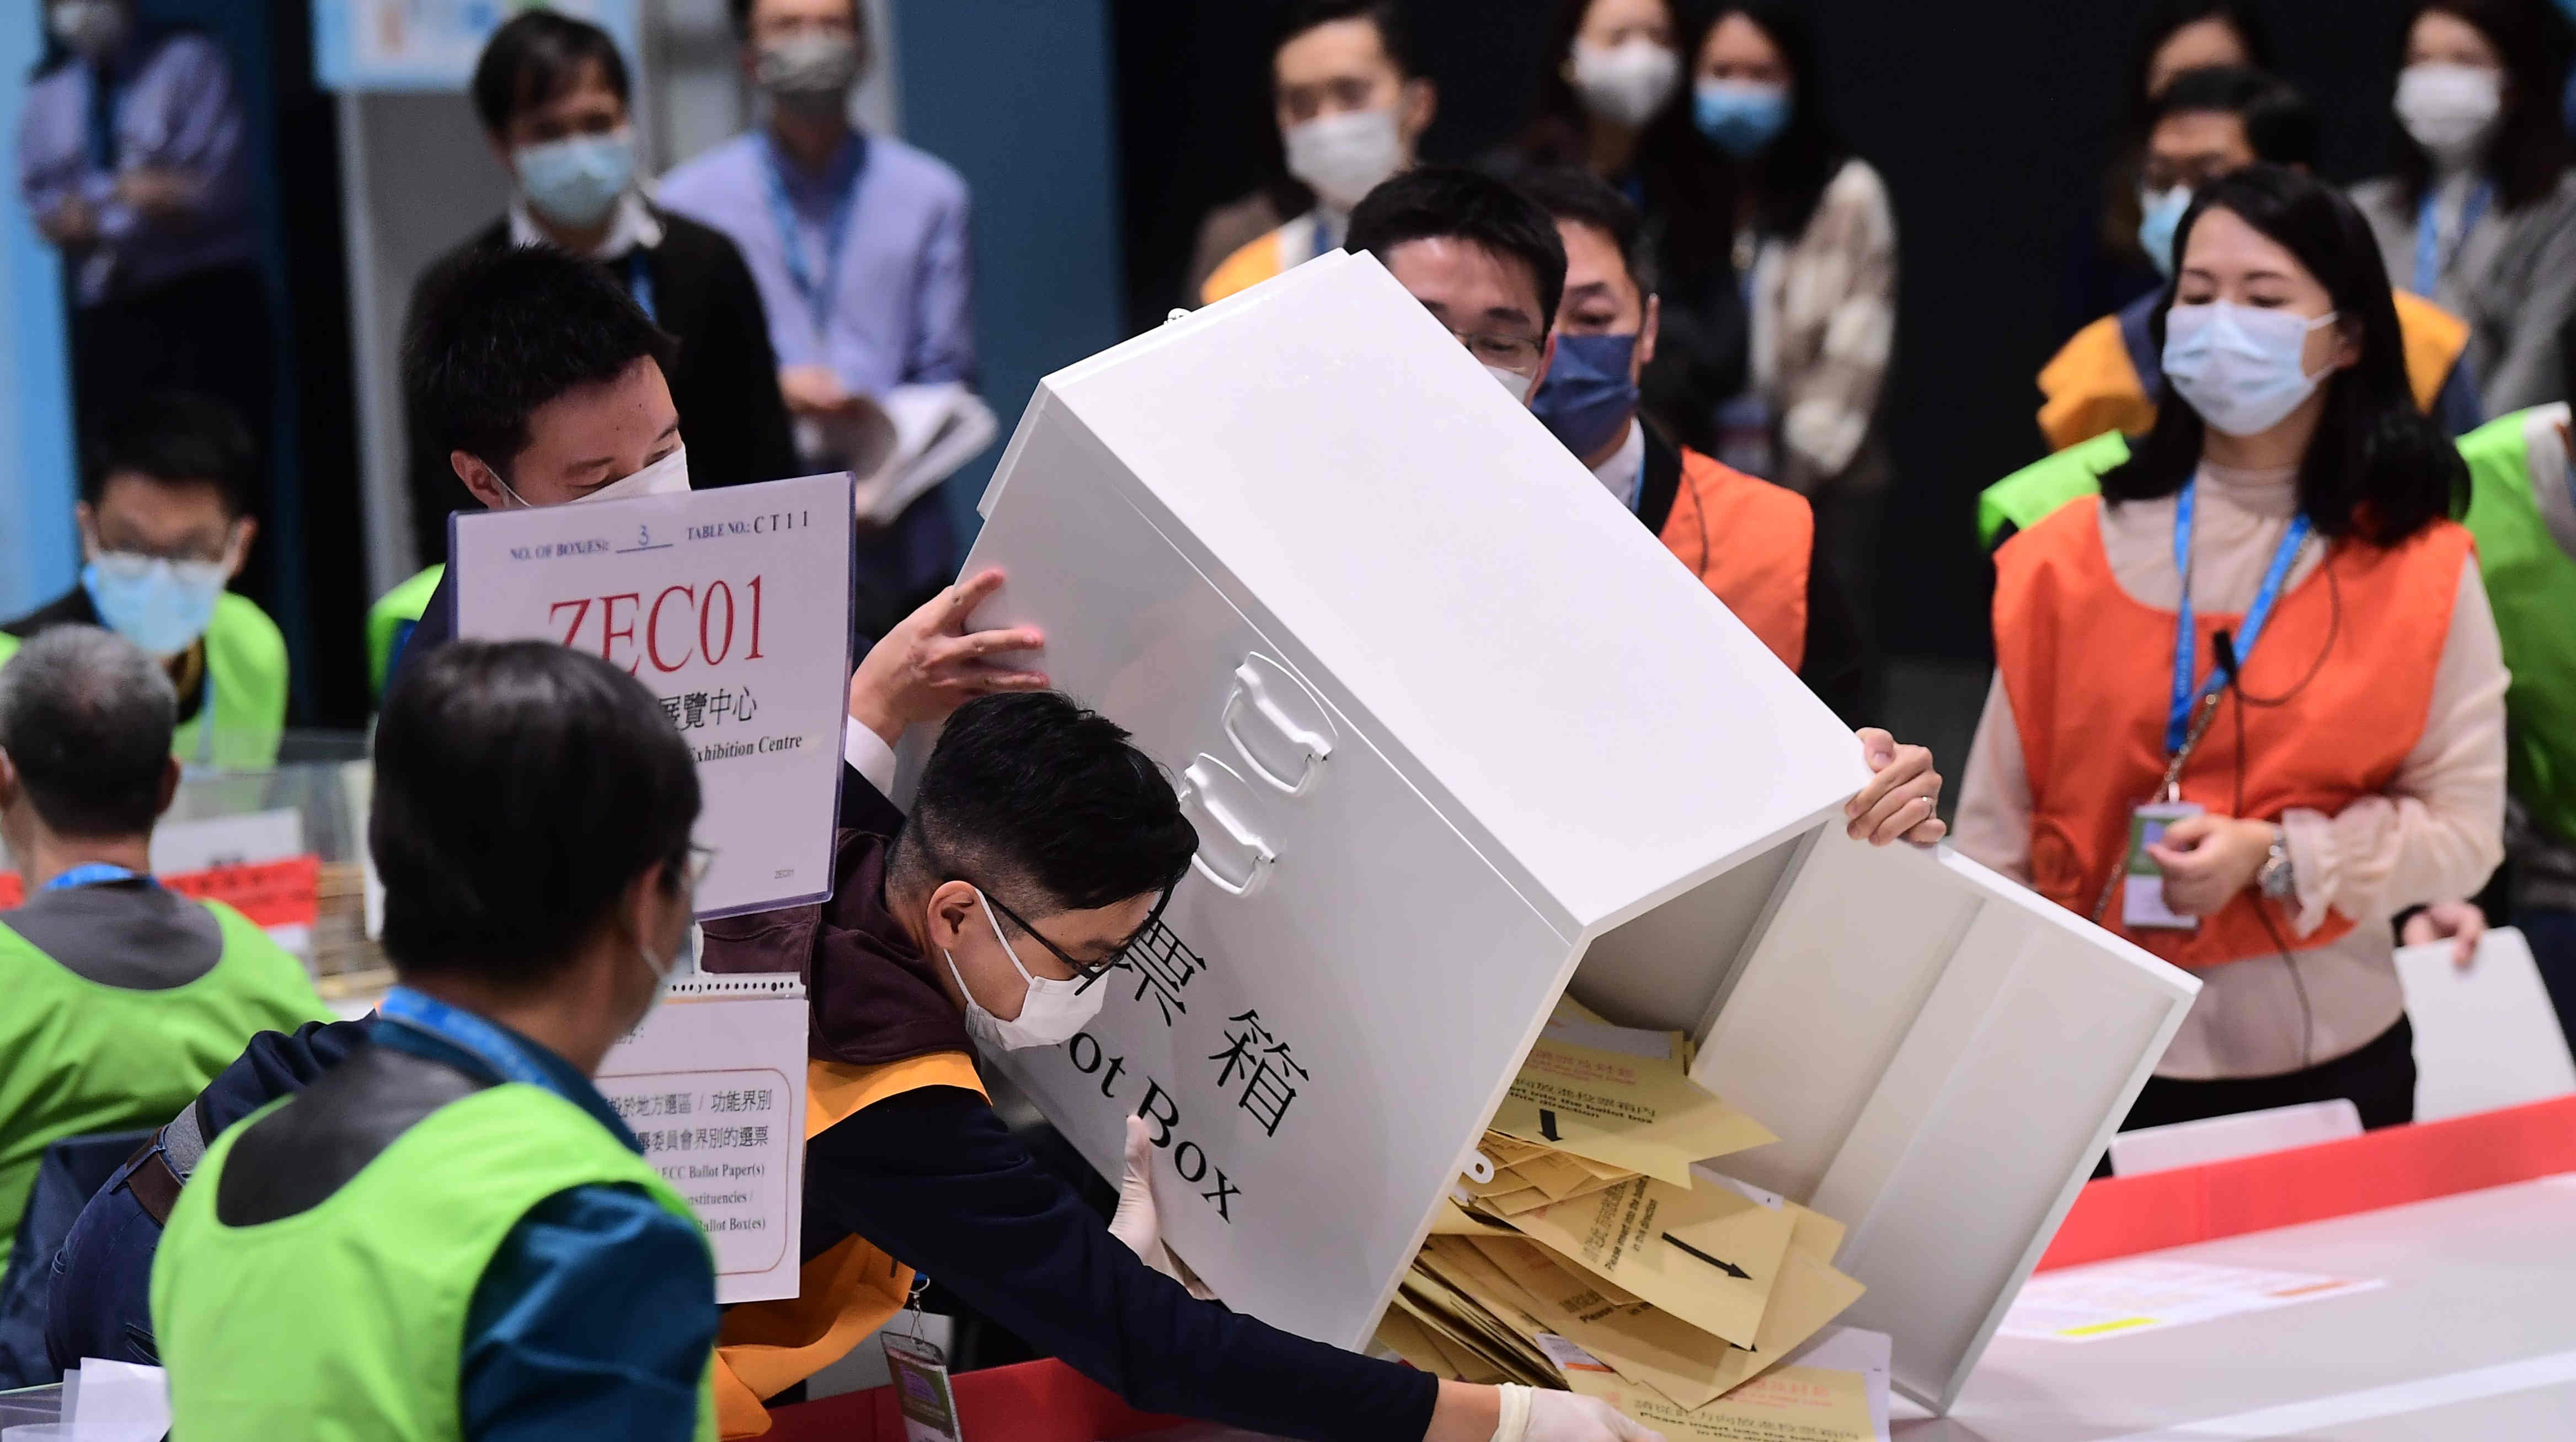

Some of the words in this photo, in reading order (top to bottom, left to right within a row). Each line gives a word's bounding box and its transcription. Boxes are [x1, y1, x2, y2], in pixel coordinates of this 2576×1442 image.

[687, 523, 724, 540] TABLE
[549, 575, 764, 676] ZEC01
[758, 735, 802, 754] Centre
[710, 1089, 772, 1113] 功能界別
[1127, 1076, 1242, 1224] Box
[689, 1165, 718, 1179] Ballot
[722, 1163, 765, 1180] Paper(s)
[730, 1216, 765, 1231] Box(es)
